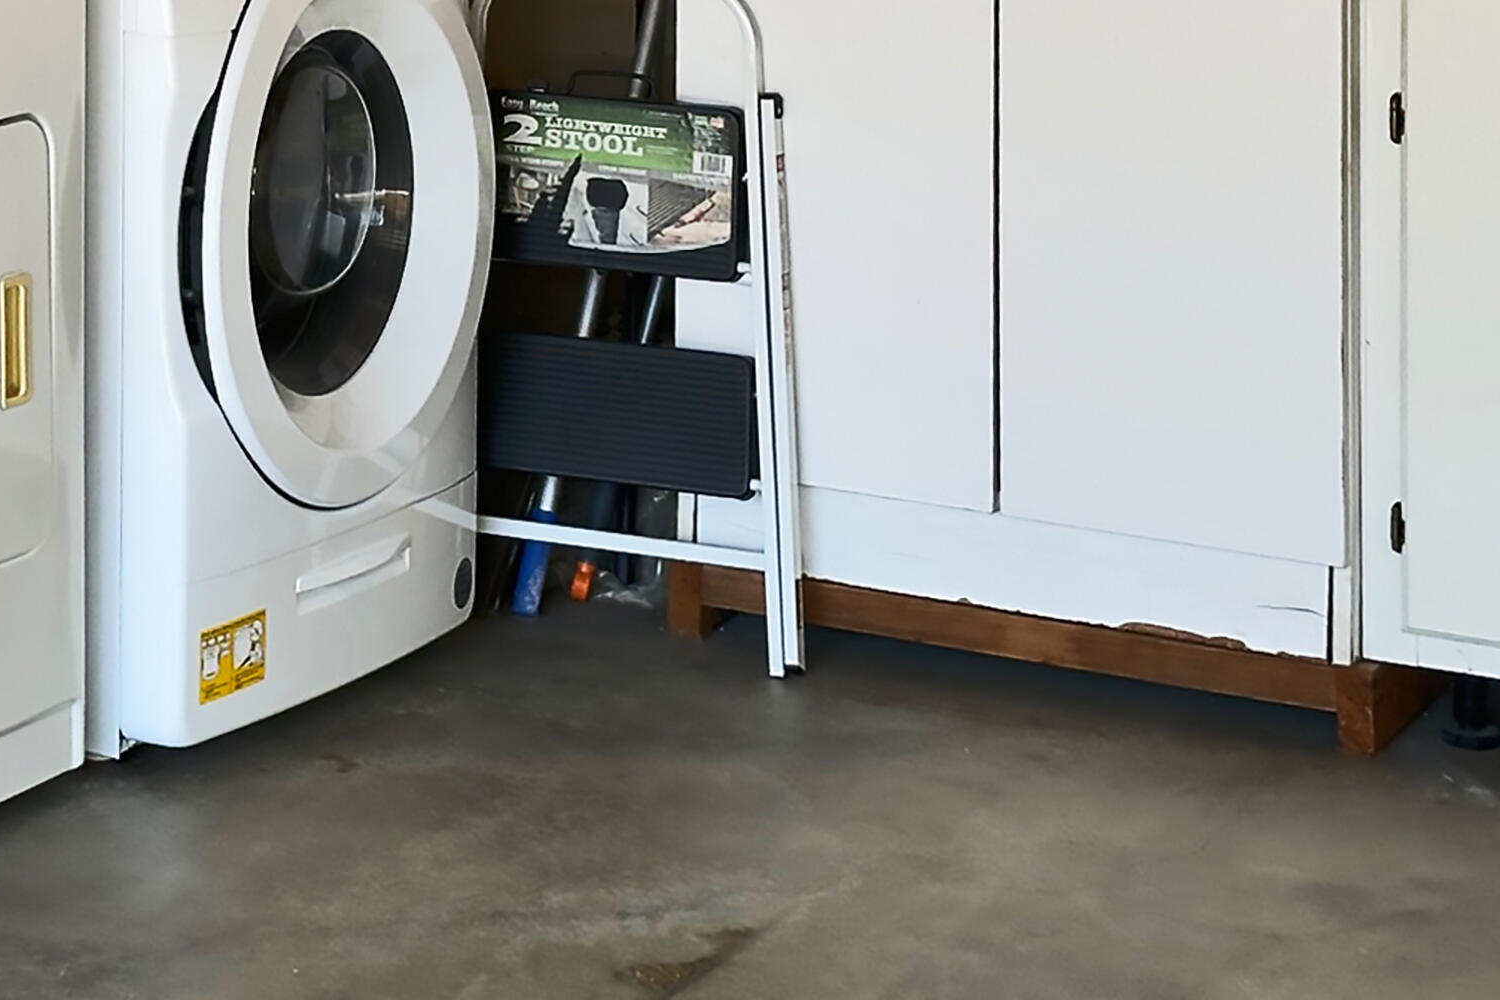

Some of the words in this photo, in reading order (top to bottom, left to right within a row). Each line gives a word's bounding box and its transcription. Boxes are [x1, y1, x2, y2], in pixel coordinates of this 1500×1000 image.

[530, 99, 559, 112] Reach
[503, 113, 542, 145] 2
[545, 116, 667, 139] LIGHTWEIGHT
[545, 128, 643, 157] STOOL
